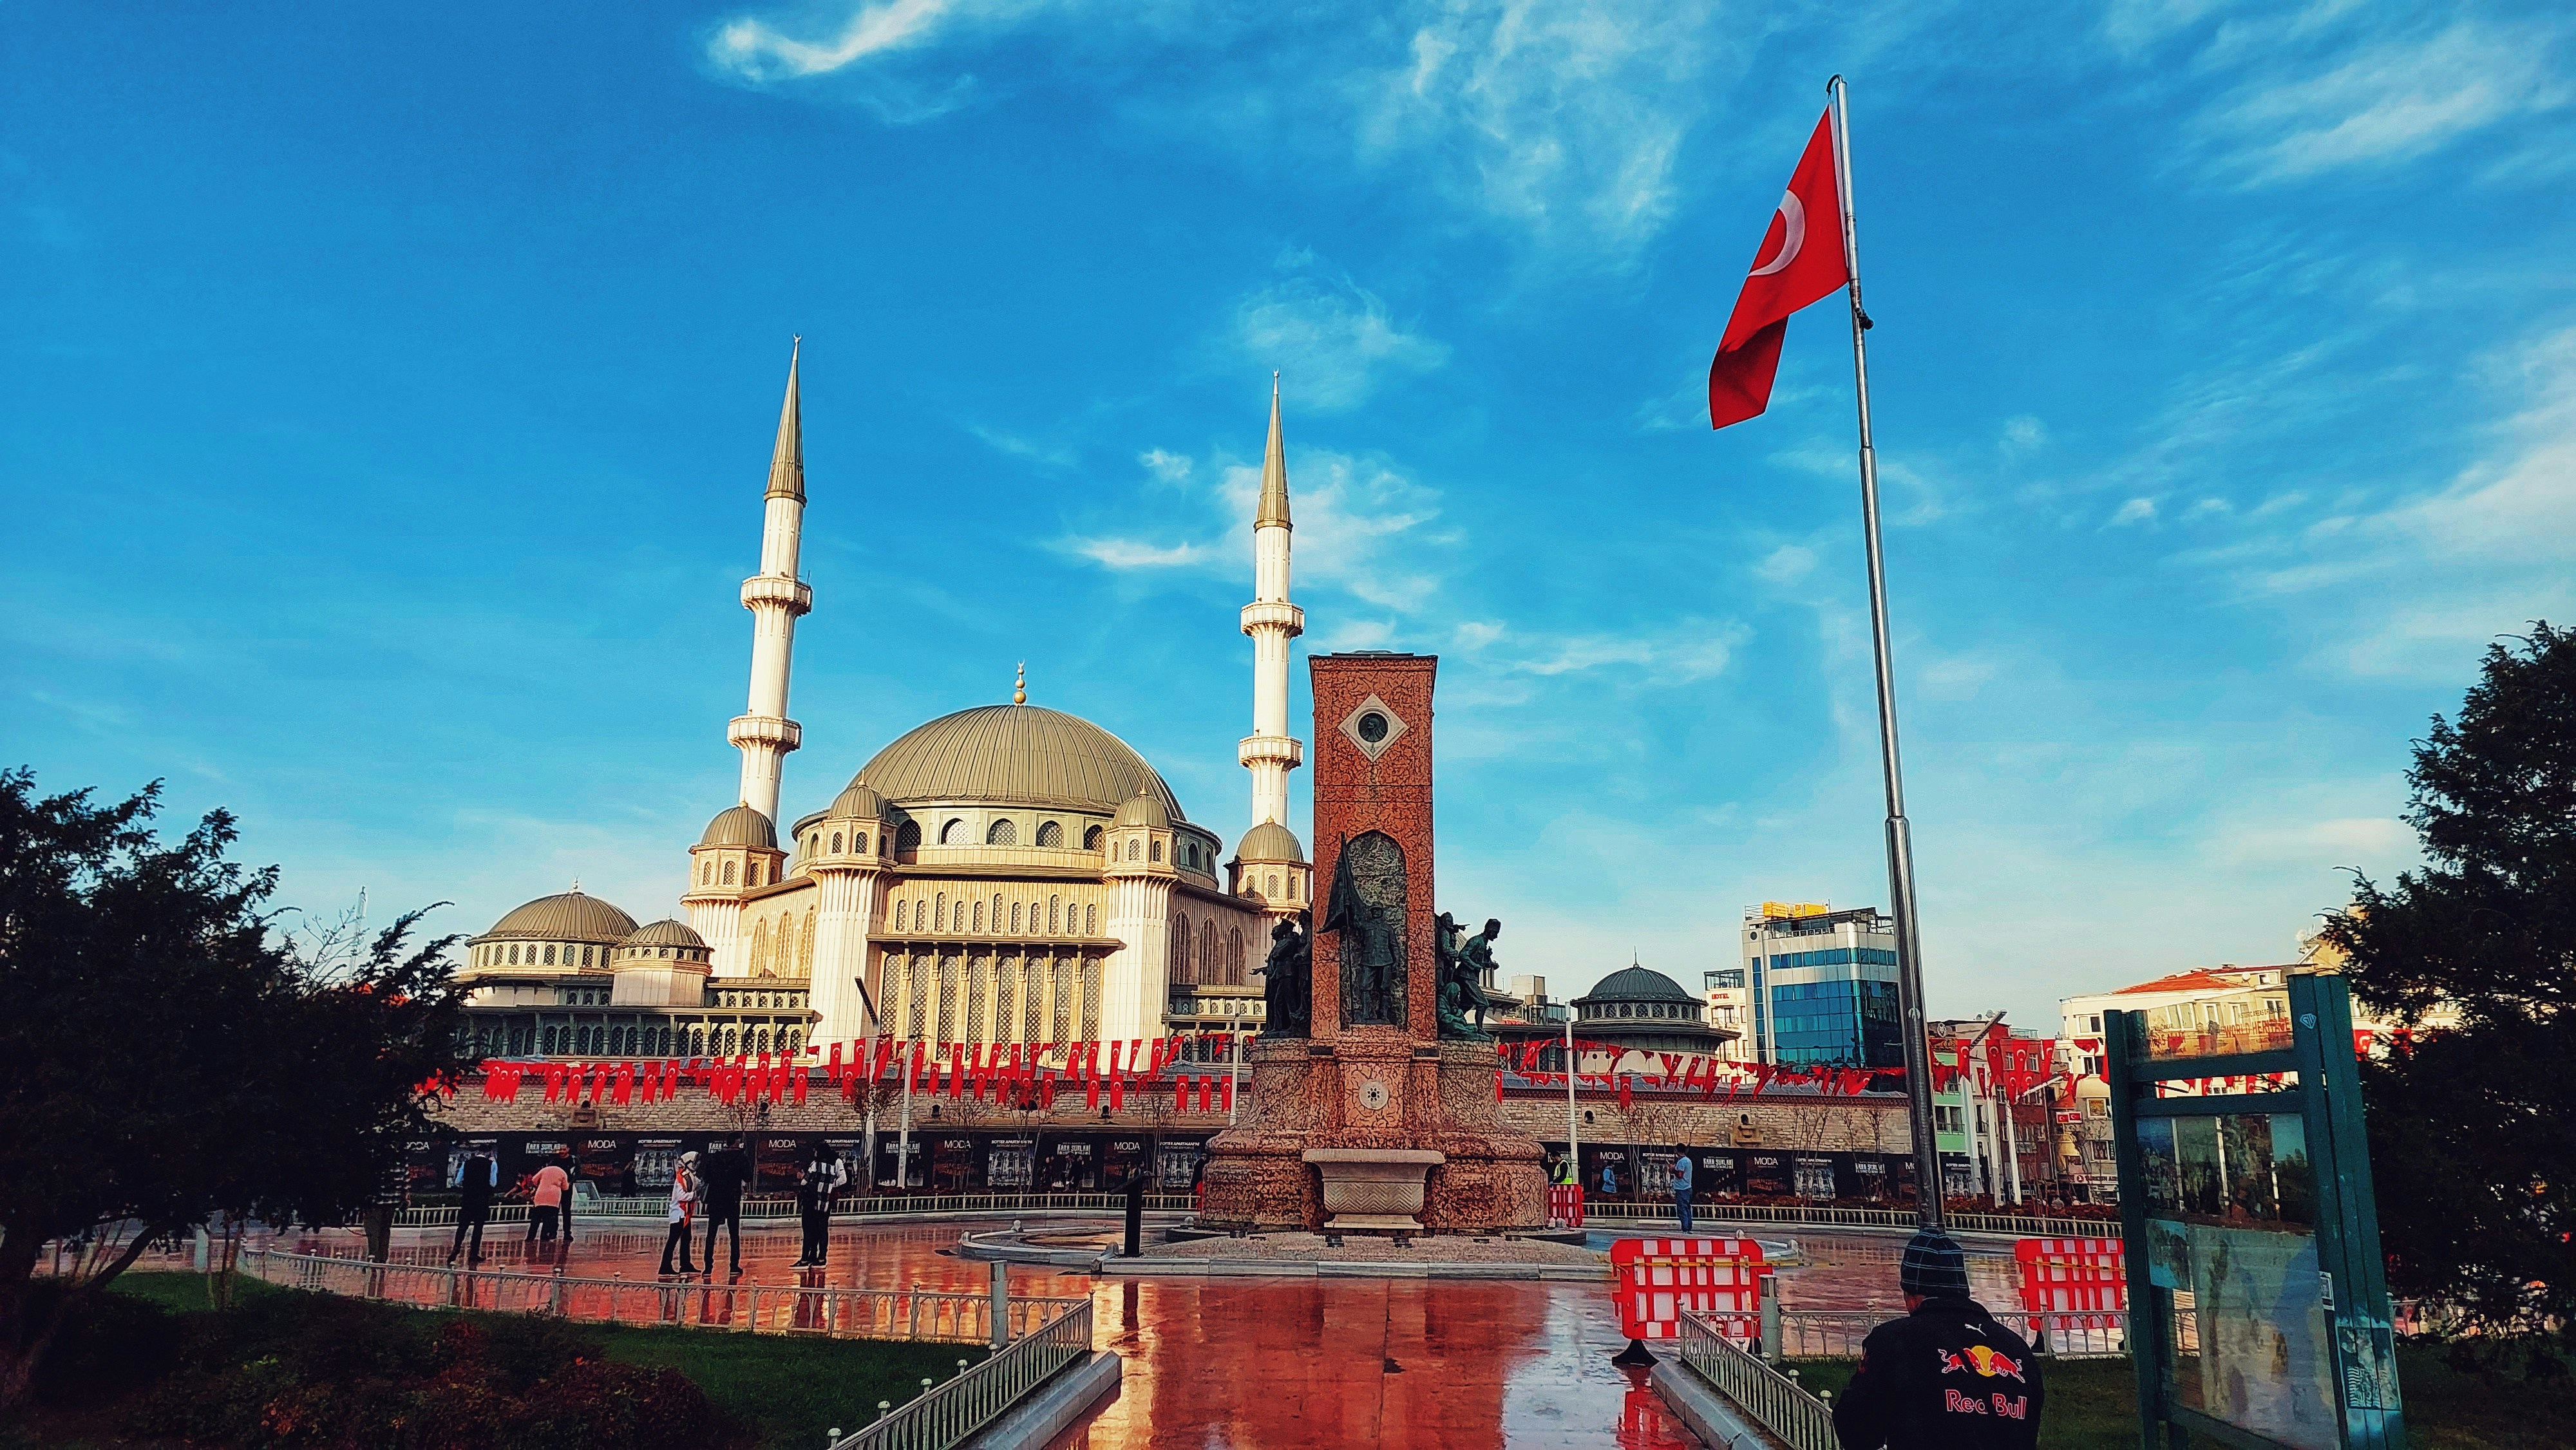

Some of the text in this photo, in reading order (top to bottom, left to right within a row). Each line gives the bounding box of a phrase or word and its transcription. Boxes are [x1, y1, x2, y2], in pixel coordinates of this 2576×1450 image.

[588, 1140, 616, 1149] MODA
[768, 1139, 797, 1148] MODA
[944, 1140, 971, 1149] MODA
[1113, 1142, 1141, 1150] MODA
[1600, 1151, 1625, 1160] MODA
[1754, 1157, 1779, 1165] MODA
[1992, 1393, 2027, 1420] Bull
